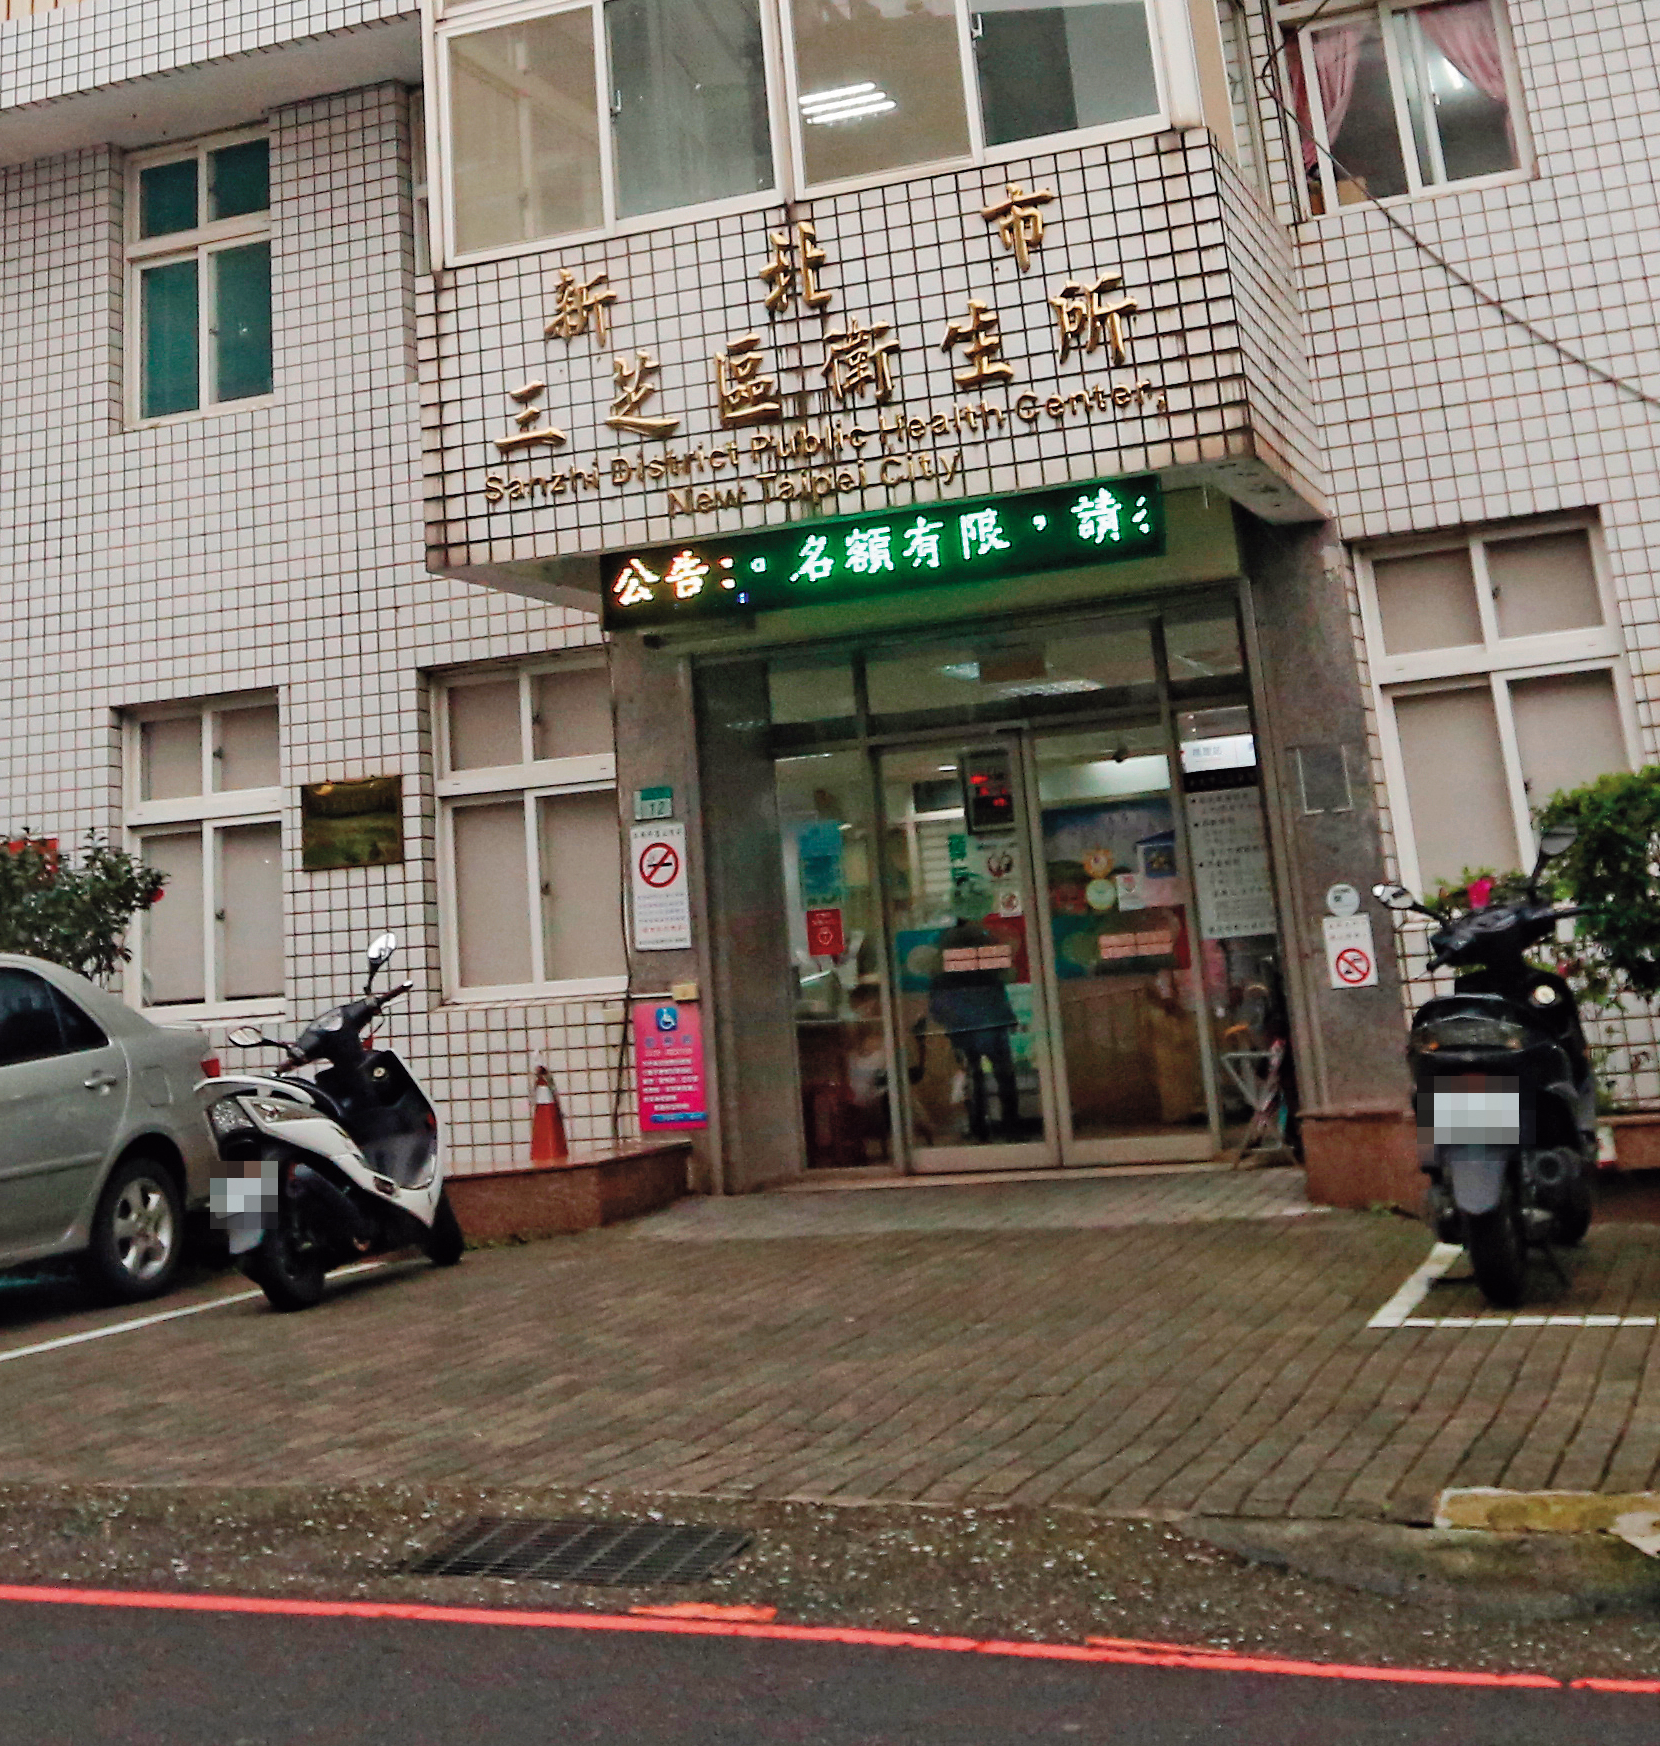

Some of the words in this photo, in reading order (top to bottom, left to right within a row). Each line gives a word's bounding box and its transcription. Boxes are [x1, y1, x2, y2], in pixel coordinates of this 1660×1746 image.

[544, 182, 1054, 348] 新北市
[493, 271, 1139, 454] 三芝區衛生所
[484, 461, 601, 505] Sanzhi
[610, 440, 739, 487] District
[751, 419, 867, 462] Public
[879, 399, 1006, 444] Health
[1015, 379, 1167, 423] Center,
[668, 483, 748, 518] New
[754, 459, 867, 505] Taipei
[880, 450, 962, 486] City
